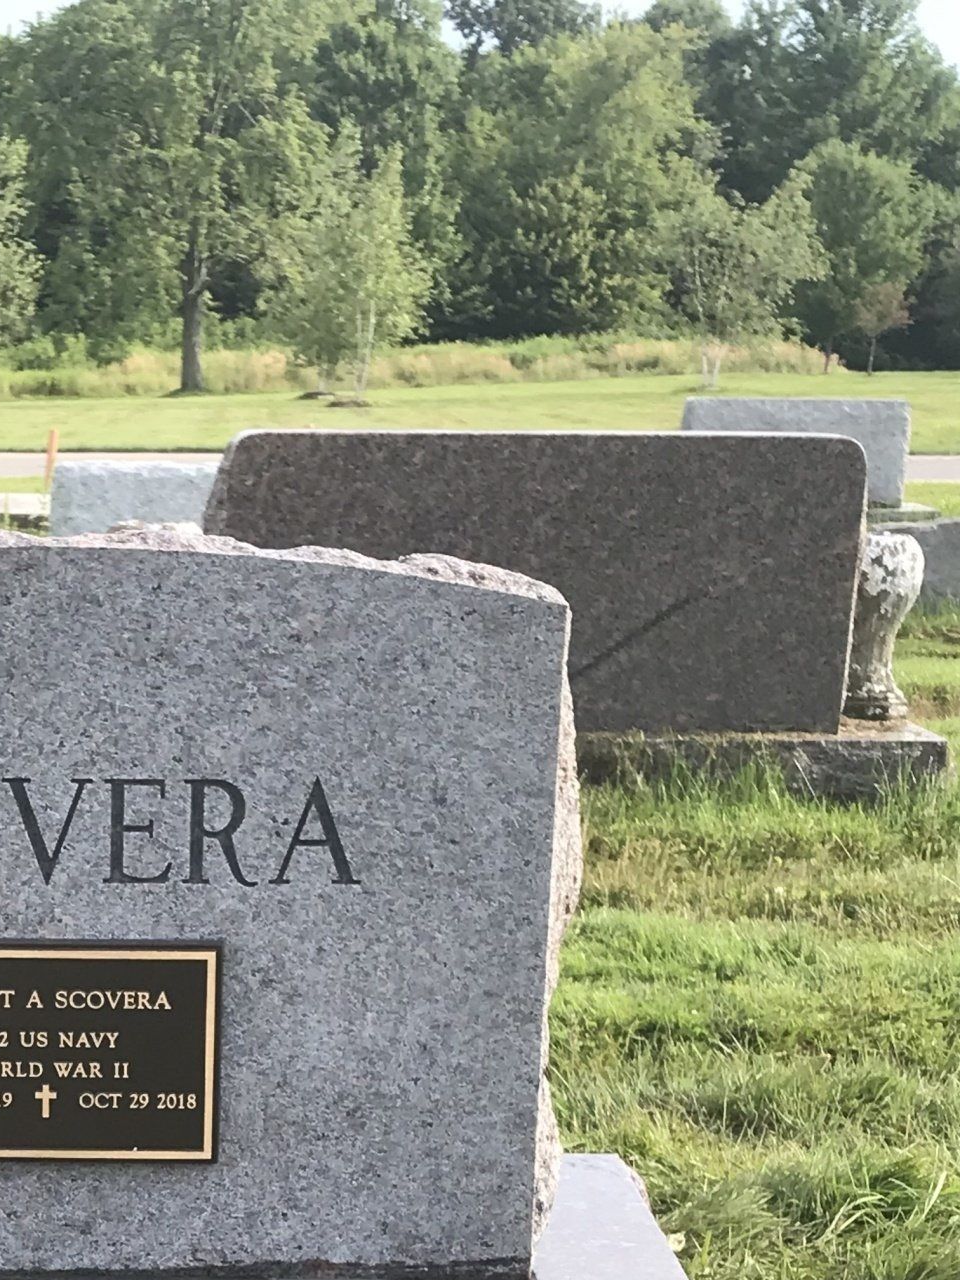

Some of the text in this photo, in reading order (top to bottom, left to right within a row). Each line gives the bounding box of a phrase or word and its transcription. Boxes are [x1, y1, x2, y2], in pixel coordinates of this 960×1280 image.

[26, 991, 43, 1009] A
[54, 991, 172, 1010] SCOVERA
[20, 1032, 48, 1048] US
[58, 1033, 119, 1049] NAVY
[53, 1062, 103, 1079] WAR
[113, 1063, 130, 1079] II
[78, 1093, 197, 1109] OCT 29 2018
